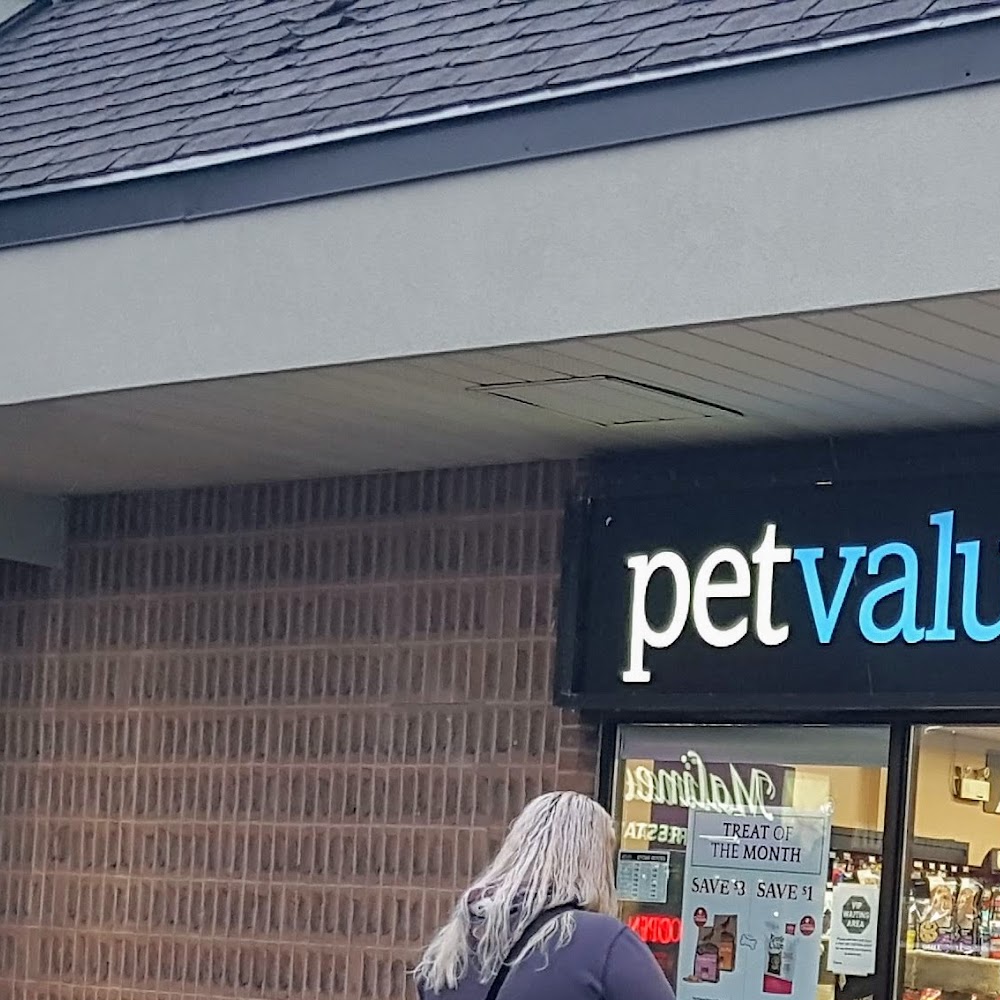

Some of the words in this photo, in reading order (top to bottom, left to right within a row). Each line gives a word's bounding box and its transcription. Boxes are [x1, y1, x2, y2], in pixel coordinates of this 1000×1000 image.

[723, 822, 769, 841] TREAT
[773, 825, 794, 842] OF
[710, 842, 739, 859] THE
[743, 845, 802, 863] MONTH
[691, 878, 730, 895] SAVE
[733, 880, 746, 897] $3
[756, 882, 798, 900] SAVE
[802, 886, 814, 901] $1
